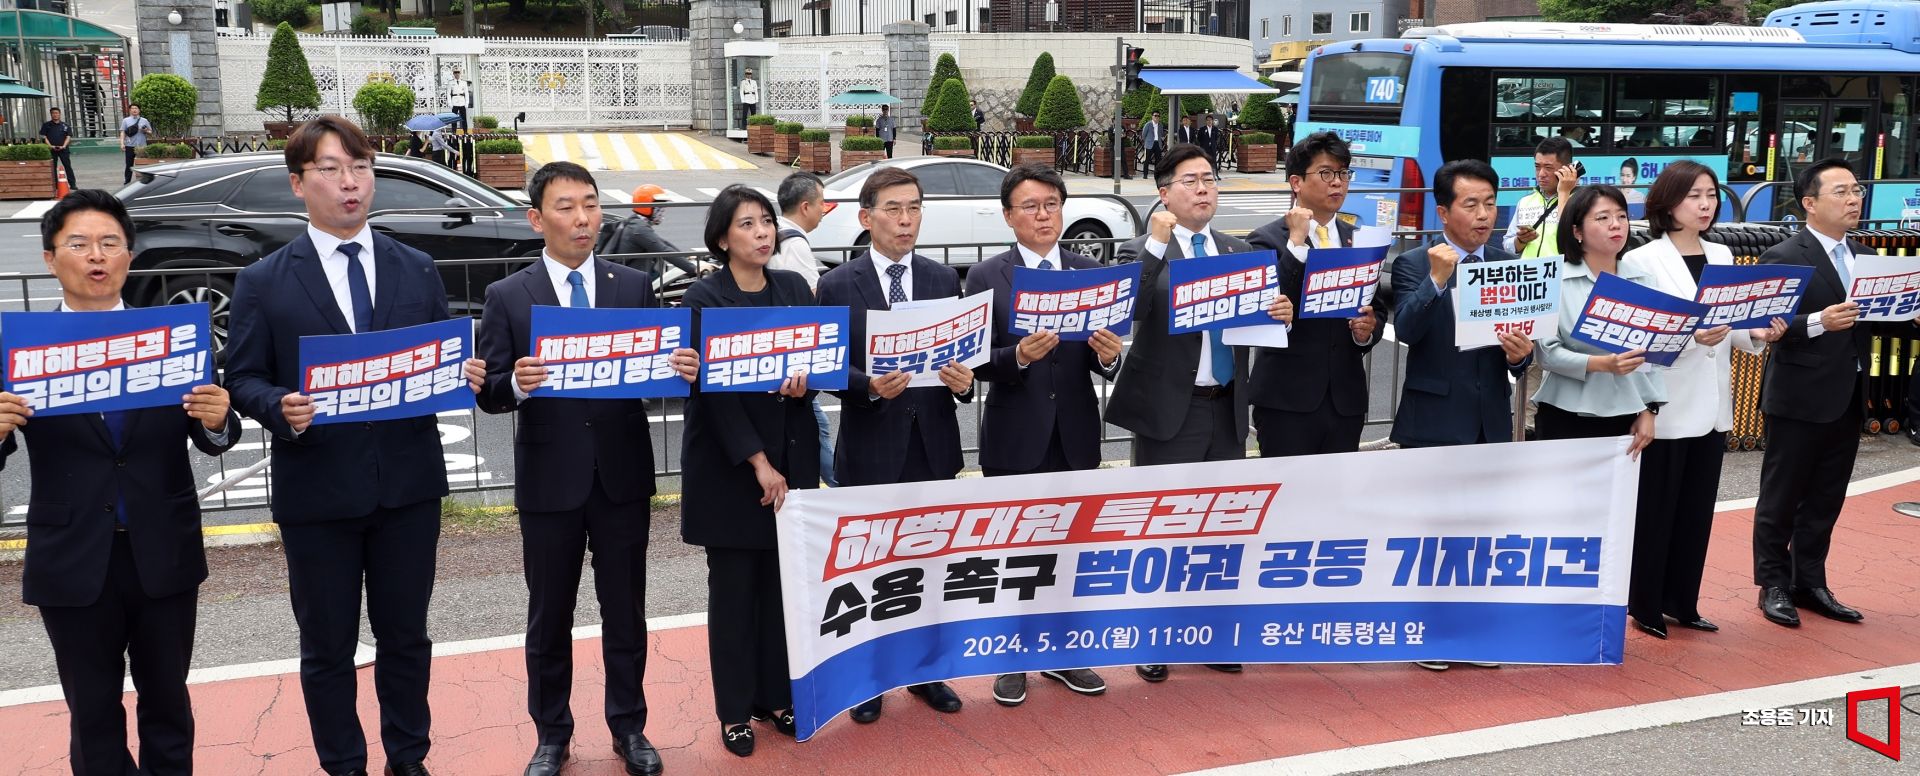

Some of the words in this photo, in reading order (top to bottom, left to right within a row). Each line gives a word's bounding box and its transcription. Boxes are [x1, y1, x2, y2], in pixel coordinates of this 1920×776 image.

[1369, 79, 1394, 101] 740
[1468, 264, 1538, 286] 거부하는
[1543, 261, 1557, 279] 자
[1304, 287, 1361, 313] 국민의
[1480, 281, 1547, 305] 범인이다
[1750, 295, 1800, 319] 명령!
[1853, 295, 1896, 318] 즉각
[872, 304, 986, 354] 채해병특검법
[1015, 311, 1086, 335] 국민의
[1087, 296, 1135, 331] 명령!
[1174, 296, 1236, 328] 국민의
[1470, 308, 1492, 318] 채상병
[1494, 307, 1508, 316] 특검
[1510, 306, 1530, 316] 거부권
[1579, 317, 1653, 351] 국민의
[707, 355, 784, 387] 국민의
[786, 346, 846, 378] 명령!
[872, 352, 928, 375] 즉각
[931, 328, 986, 371] 공포!
[13, 367, 122, 411] 국민의
[126, 350, 207, 393] 명령!
[539, 359, 622, 391] 국민의
[309, 380, 401, 417] 국민의
[834, 502, 1082, 570] 해병대원
[1091, 489, 1274, 537] 특검법
[820, 567, 925, 638] 수용
[943, 553, 1058, 604] 촉구
[1073, 543, 1245, 597] 범야권
[1258, 538, 1369, 588] 공동
[1386, 534, 1602, 588] 기자회견
[963, 633, 1029, 657] 2024.
[1037, 632, 1057, 652] 5.
[1149, 625, 1213, 646] 11:00
[1260, 622, 1305, 646] 용산
[1312, 621, 1396, 646] 대통령실
[1404, 621, 1425, 646] 앞
